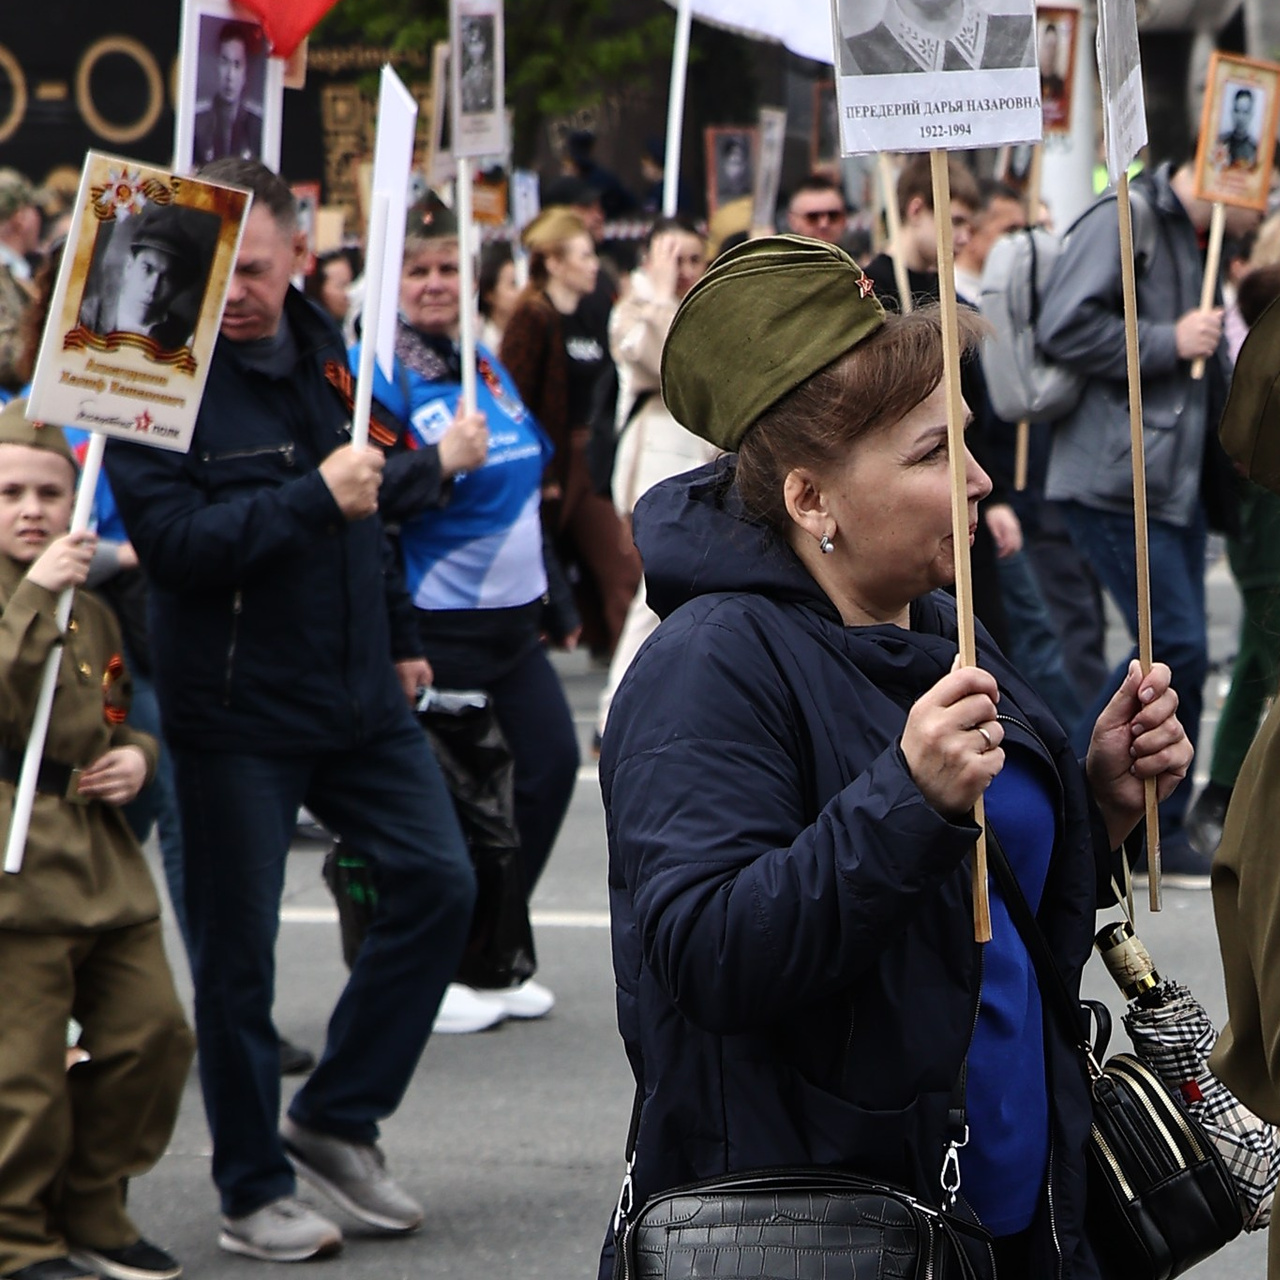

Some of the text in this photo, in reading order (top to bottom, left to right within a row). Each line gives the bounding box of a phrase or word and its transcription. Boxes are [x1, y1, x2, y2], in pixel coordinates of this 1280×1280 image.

[846, 96, 1041, 119] ПЕРЕДЕРИЙ ДАРЬЯ НАЗАРОВНА
[920, 124, 972, 138] 1922-1994
